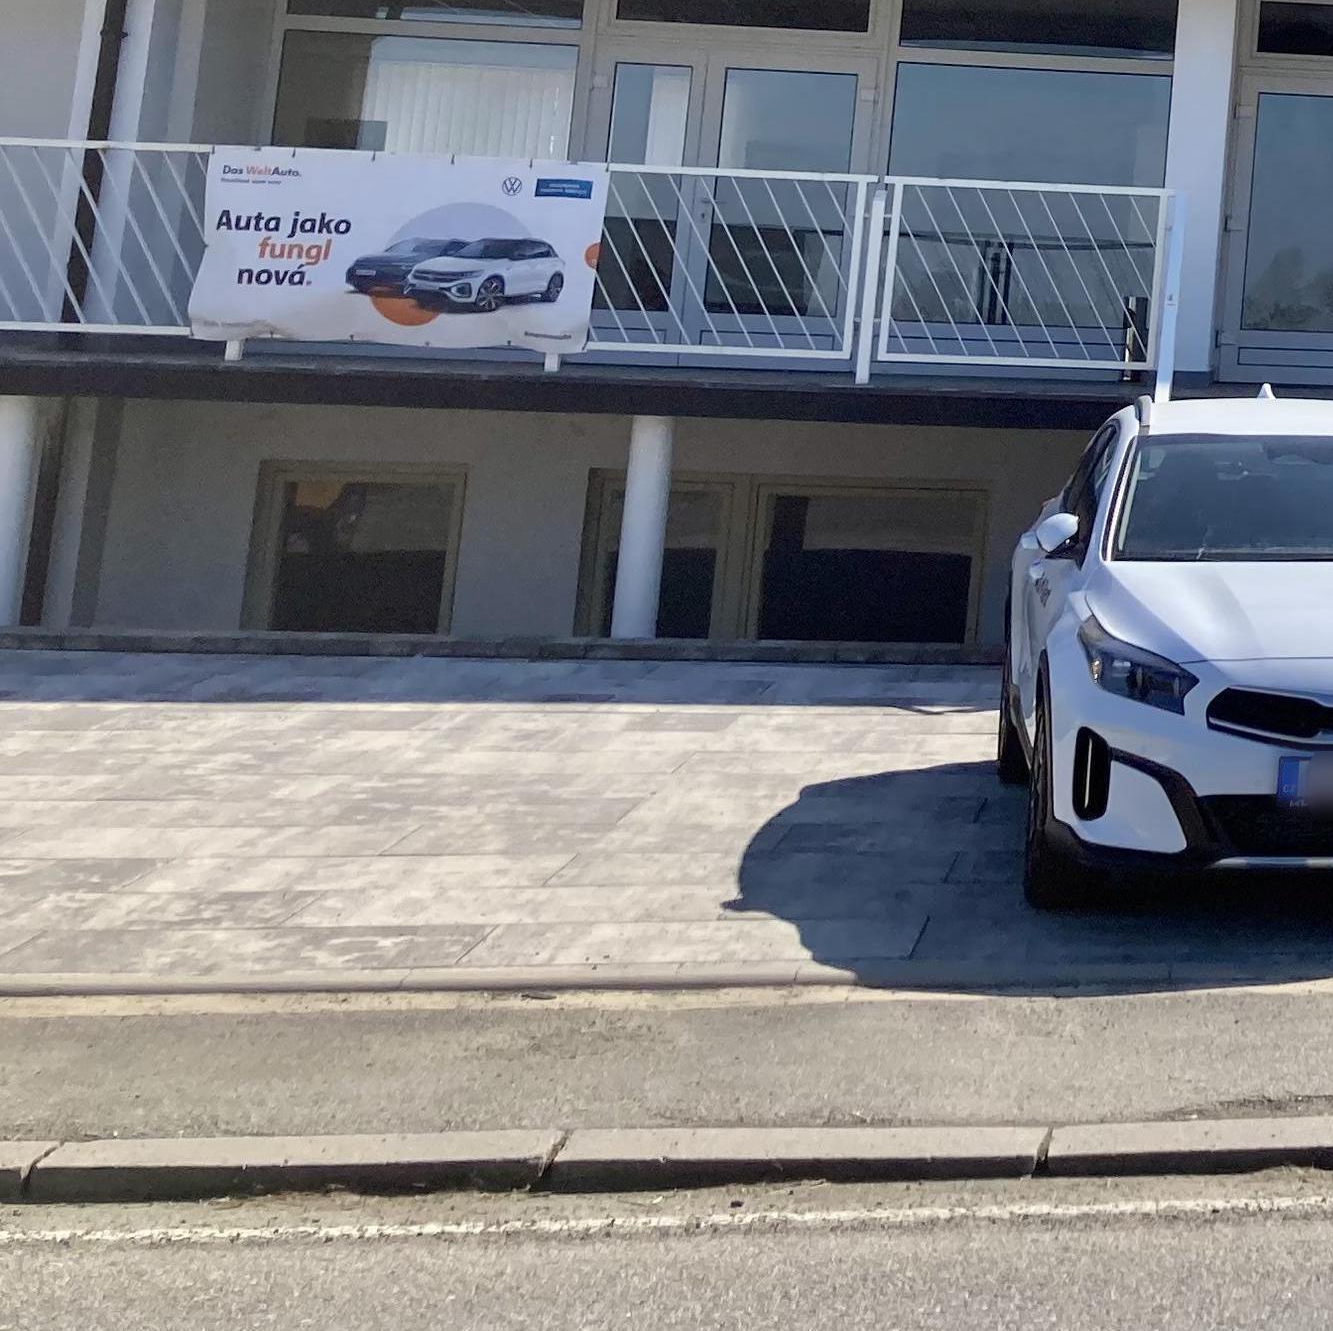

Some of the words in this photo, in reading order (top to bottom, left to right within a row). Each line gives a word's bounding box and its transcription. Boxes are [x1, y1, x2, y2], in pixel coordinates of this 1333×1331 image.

[216, 209, 282, 232] Auta
[286, 211, 352, 239] jako
[258, 236, 332, 266] fungl
[237, 263, 313, 286] nová.
